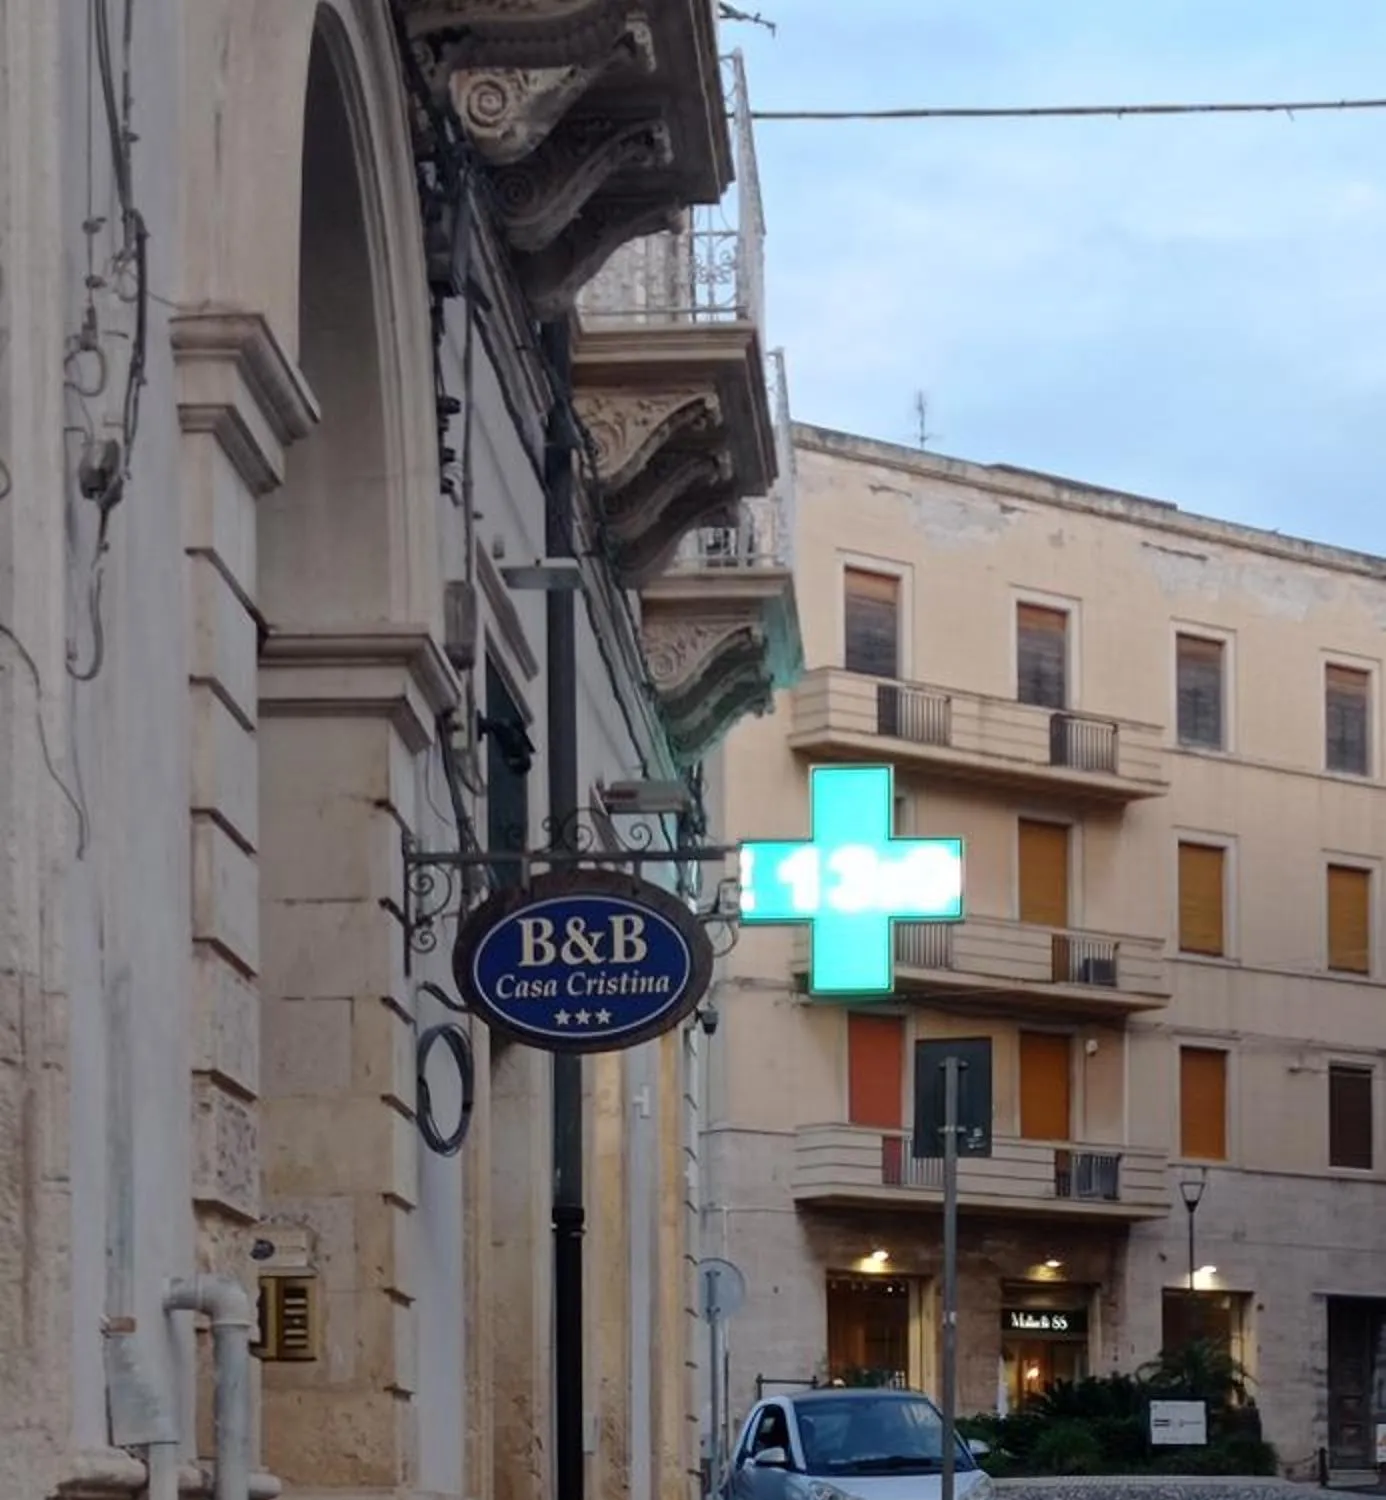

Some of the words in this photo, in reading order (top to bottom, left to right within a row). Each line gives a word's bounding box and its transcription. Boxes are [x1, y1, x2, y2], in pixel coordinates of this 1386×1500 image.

[516, 914, 648, 967] B&B
[496, 974, 557, 999] Casa
[567, 970, 670, 996] Cristina
